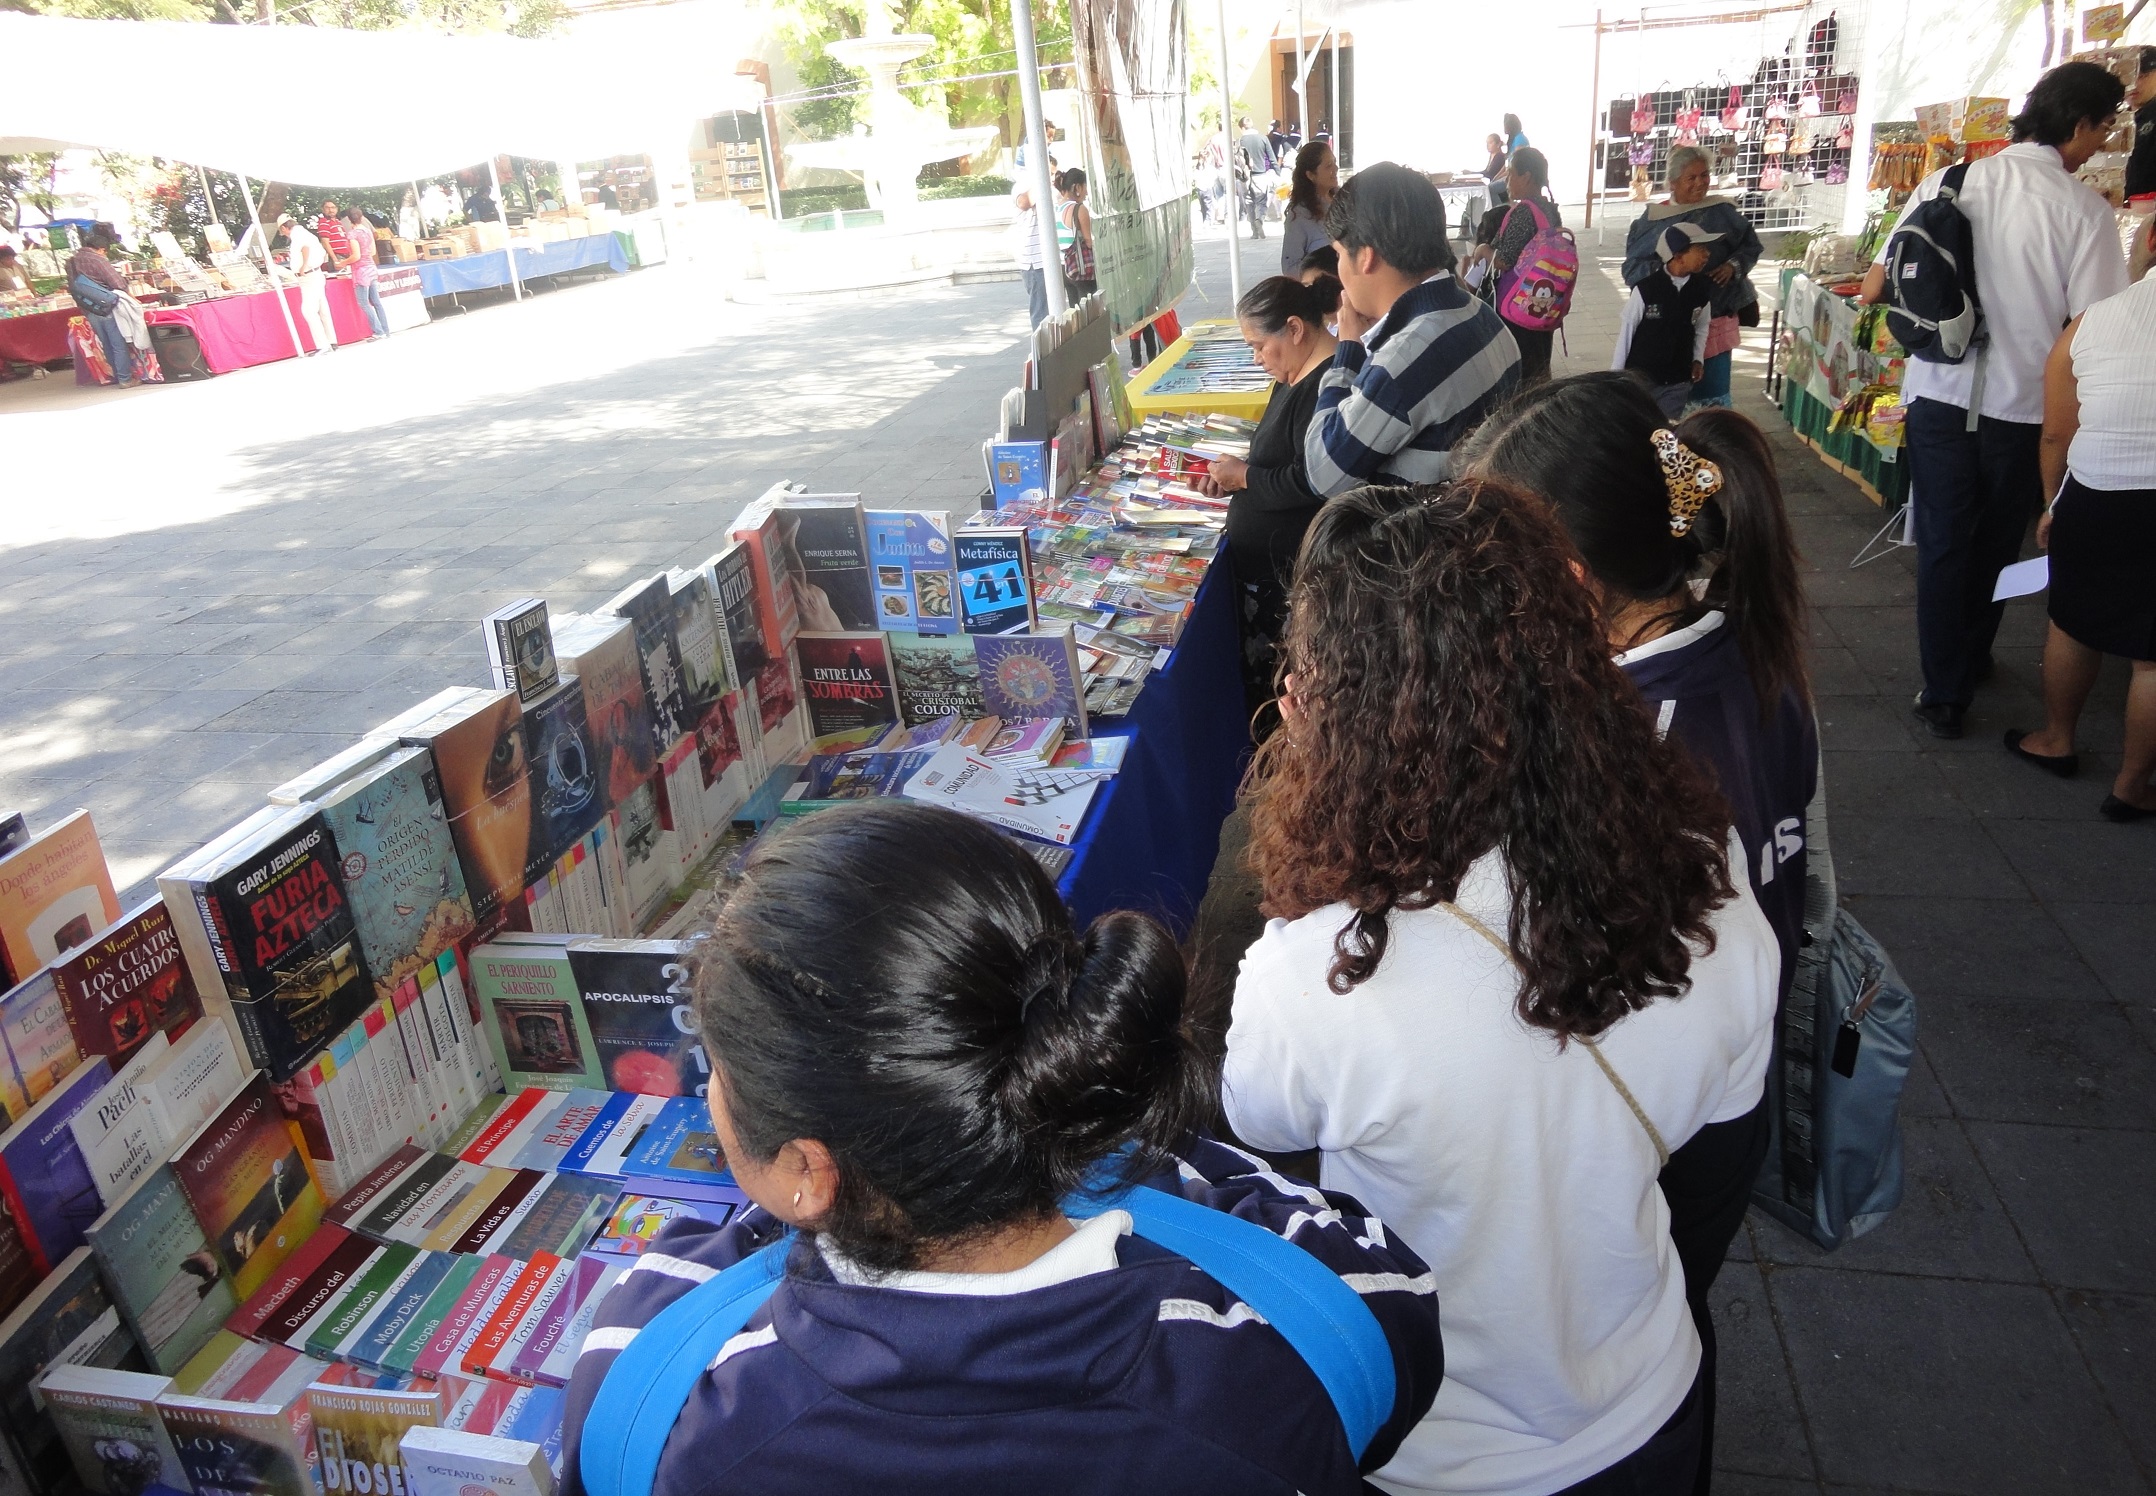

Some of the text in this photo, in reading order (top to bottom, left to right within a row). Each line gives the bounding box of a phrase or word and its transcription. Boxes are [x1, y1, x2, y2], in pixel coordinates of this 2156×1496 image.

[804, 550, 834, 558] ENRIQUE
[961, 547, 1018, 560] Metafísica
[722, 567, 753, 610] HITLER
[973, 573, 1001, 604] 4
[1002, 567, 1025, 599] 1
[713, 598, 726, 630] HITLER
[809, 680, 884, 699] SOMBRAS
[813, 668, 872, 680] ENTRE LAS
[914, 702, 961, 715] COLÓN
[922, 695, 977, 705] CRISTÓBAL
[1014, 716, 1022, 726] 7
[944, 764, 980, 795] COMUNIDAD
[377, 816, 423, 854] ORIGEN
[1000, 816, 1044, 836] COMUNIDAD
[48, 830, 94, 862] habitan
[236, 829, 322, 896] GARY JENNINGS
[377, 828, 430, 870] PERDIDO
[525, 852, 551, 874] MEYER
[0, 856, 47, 897] Donde
[380, 844, 436, 888] MATILDE
[392, 860, 433, 897] ASENSI
[20, 879, 38, 900] los
[250, 859, 329, 933] FURIA
[85, 913, 165, 971] Dr. Miguel Ruiz
[196, 894, 231, 973] GARY JENNINGS
[254, 883, 342, 968] AZTECA
[80, 961, 116, 1000] LOS
[99, 946, 180, 1012] ACUERDOS
[487, 963, 557, 981] EL PERIQUILLO
[501, 981, 555, 996] SARNIENTO
[584, 992, 675, 1005] APOCALIPSIS
[431, 1016, 447, 1053] MÁRTIR
[435, 1002, 455, 1049] GÓLGOTA
[123, 1063, 147, 1089] Emilio
[378, 1057, 398, 1106] PERIQUILLO
[527, 1074, 574, 1085] José Joaquín
[340, 1110, 358, 1155] COMEDIAS
[543, 1106, 585, 1146] EL ARTE
[555, 1104, 604, 1149] DE AMAR
[624, 1101, 645, 1128] Selva
[123, 1127, 143, 1149] Las
[197, 1153, 214, 1173] OG
[214, 1097, 263, 1154] MANDINO
[447, 1134, 467, 1157] Libro
[465, 1125, 476, 1142] de
[475, 1114, 487, 1130] las
[476, 1117, 516, 1155] El Príncipe
[578, 1118, 616, 1160] Cuentos de
[109, 1140, 148, 1185] batallas
[129, 1152, 153, 1181] en el
[343, 1159, 407, 1213] Pepita Jiménez
[382, 1181, 430, 1224] Navidad en
[417, 1167, 465, 1216] Montañas
[516, 1188, 542, 1216] Sueño
[121, 1218, 141, 1242] OG
[142, 1180, 177, 1221] MAND
[439, 1203, 478, 1244] Respuesta
[470, 1204, 511, 1244] La Vida es
[252, 1275, 301, 1321] Macbeth
[284, 1285, 328, 1330] Discurso
[326, 1270, 345, 1293] del
[330, 1289, 379, 1336] Robinson
[435, 1266, 501, 1354] Casa de Muñecas
[485, 1264, 550, 1349] Las Aventuras de
[373, 1292, 424, 1346] Moby Dick
[407, 1317, 441, 1354] Utopía
[511, 1313, 539, 1347] Tom
[533, 1313, 567, 1355] Fouché
[566, 1303, 594, 1342] Genio
[312, 1394, 431, 1417] FRANCISCO ROJAS GONZÁLEZ
[175, 1434, 235, 1455] LOS
[427, 1465, 516, 1486] OCTAVIO PAZ
